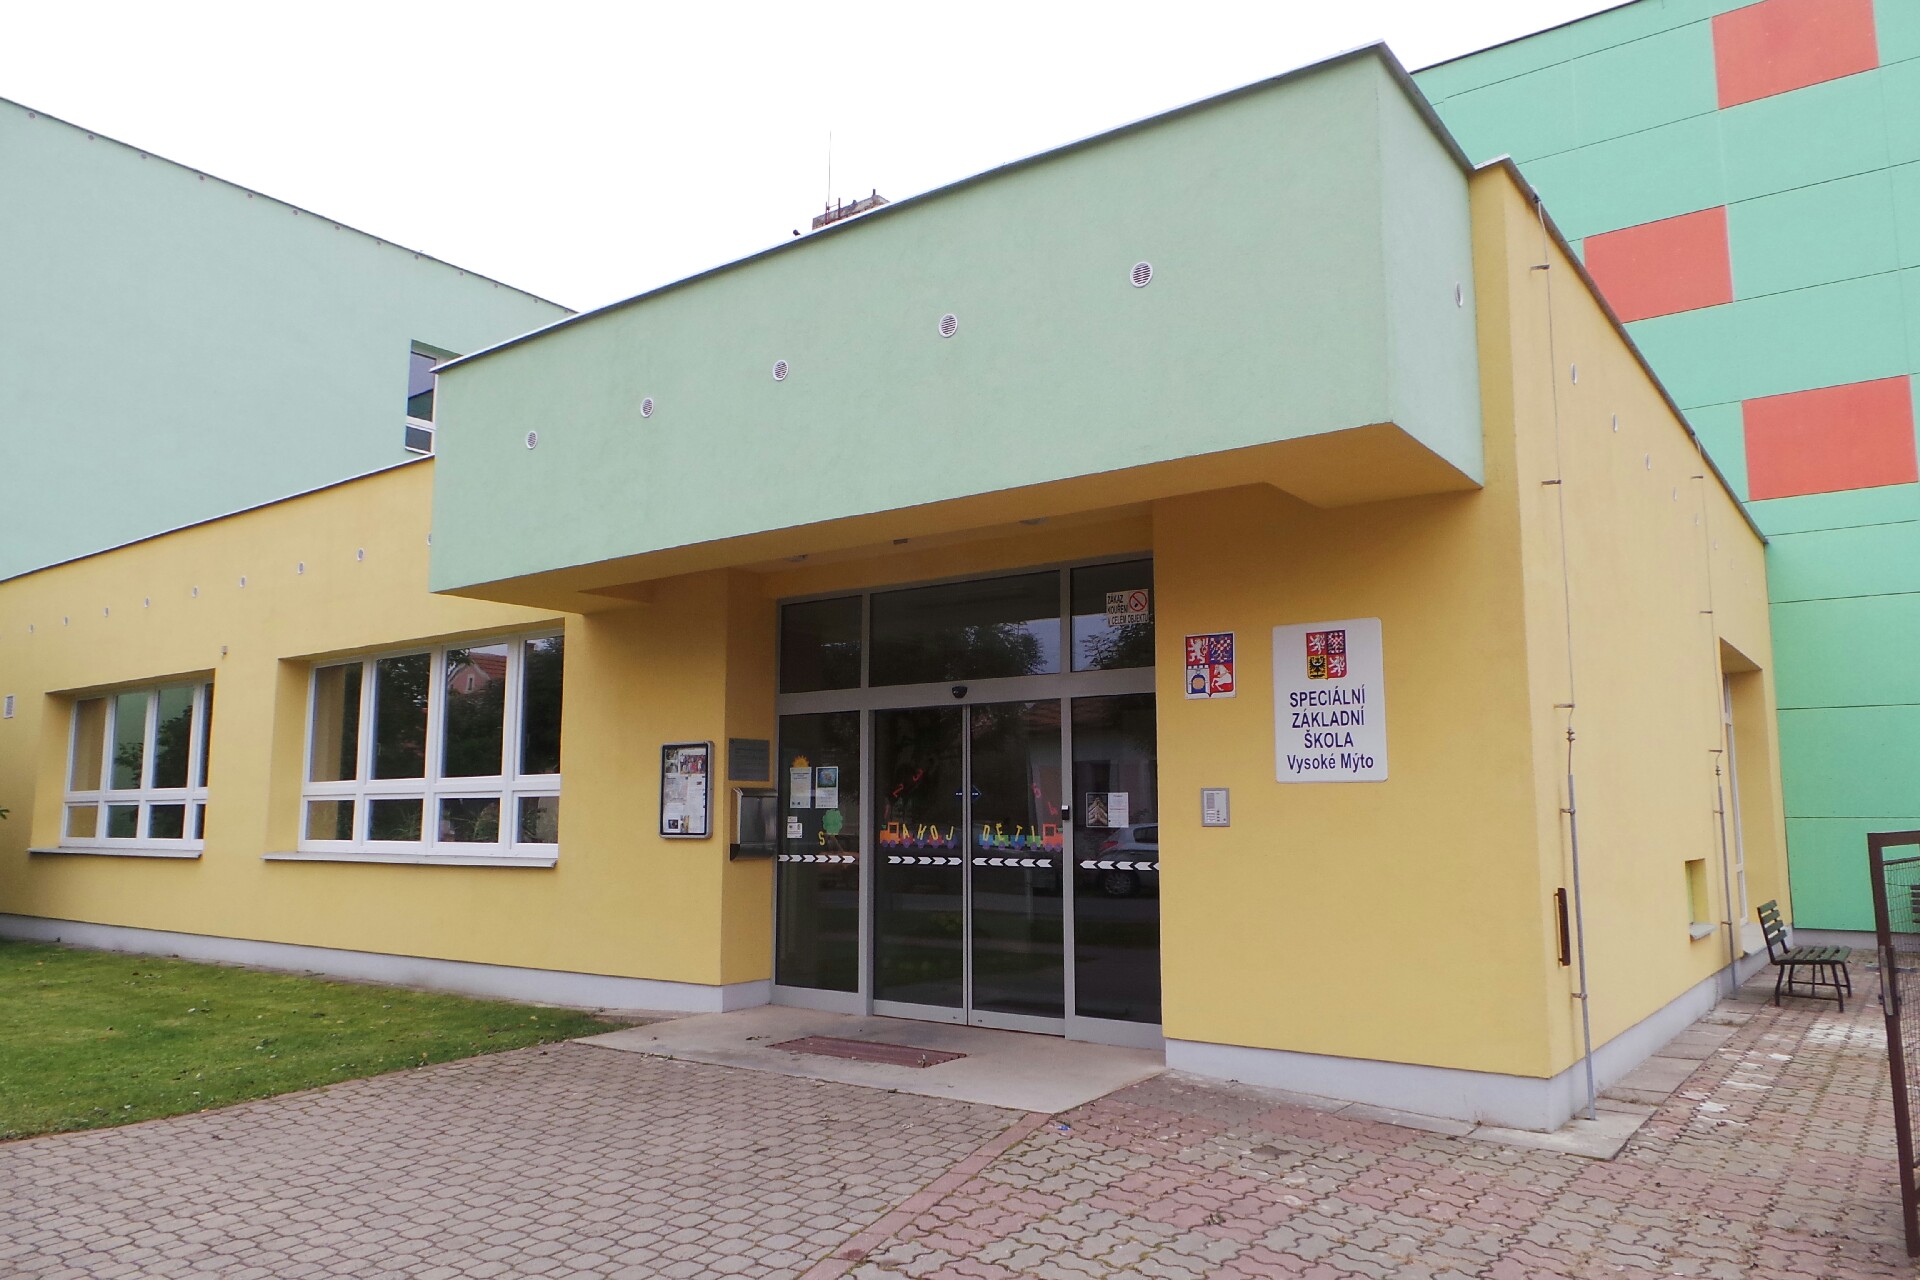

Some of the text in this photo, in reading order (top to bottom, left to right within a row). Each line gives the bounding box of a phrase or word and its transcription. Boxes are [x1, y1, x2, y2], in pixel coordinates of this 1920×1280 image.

[1290, 684, 1365, 708] SPECIÁLNÍ
[1292, 705, 1365, 728] ZÁKLADNÍ
[1304, 729, 1354, 749] ŠKOLA
[1287, 752, 1374, 774] Vysoké Mýto
